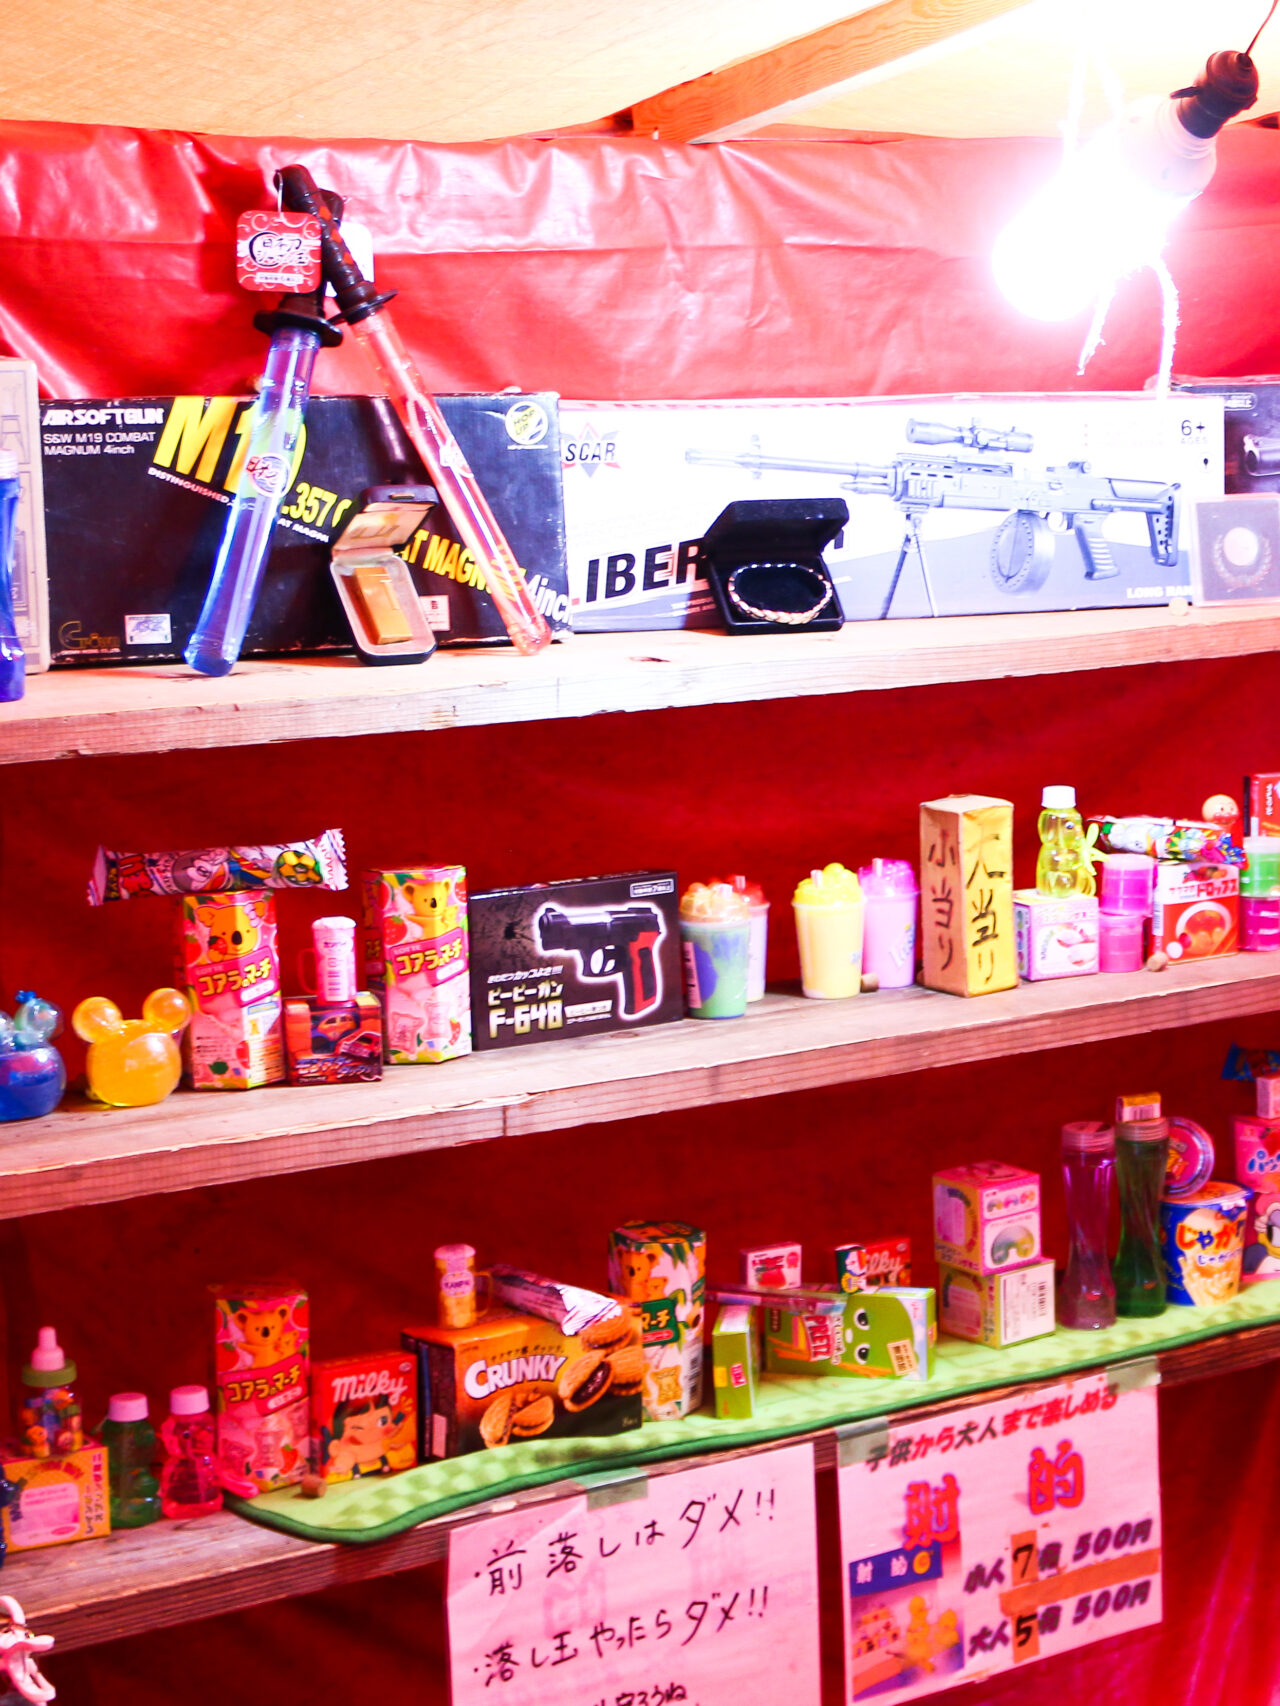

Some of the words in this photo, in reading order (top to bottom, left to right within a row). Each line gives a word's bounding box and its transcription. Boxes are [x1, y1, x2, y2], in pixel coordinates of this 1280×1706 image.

[44, 445, 100, 456] MAGNUM
[75, 432, 102, 443] M19
[105, 431, 156, 442] COMBAT
[565, 442, 616, 463] SCAR
[198, 956, 272, 996] コアラのマーチ
[489, 999, 563, 1039] F-648
[805, 1314, 832, 1360] PRETZ
[227, 1364, 301, 1402] コアラのマーチ
[332, 1369, 409, 1405] Milky
[464, 1354, 566, 1399] CRUNKY
[1028, 1438, 1085, 1516] 的
